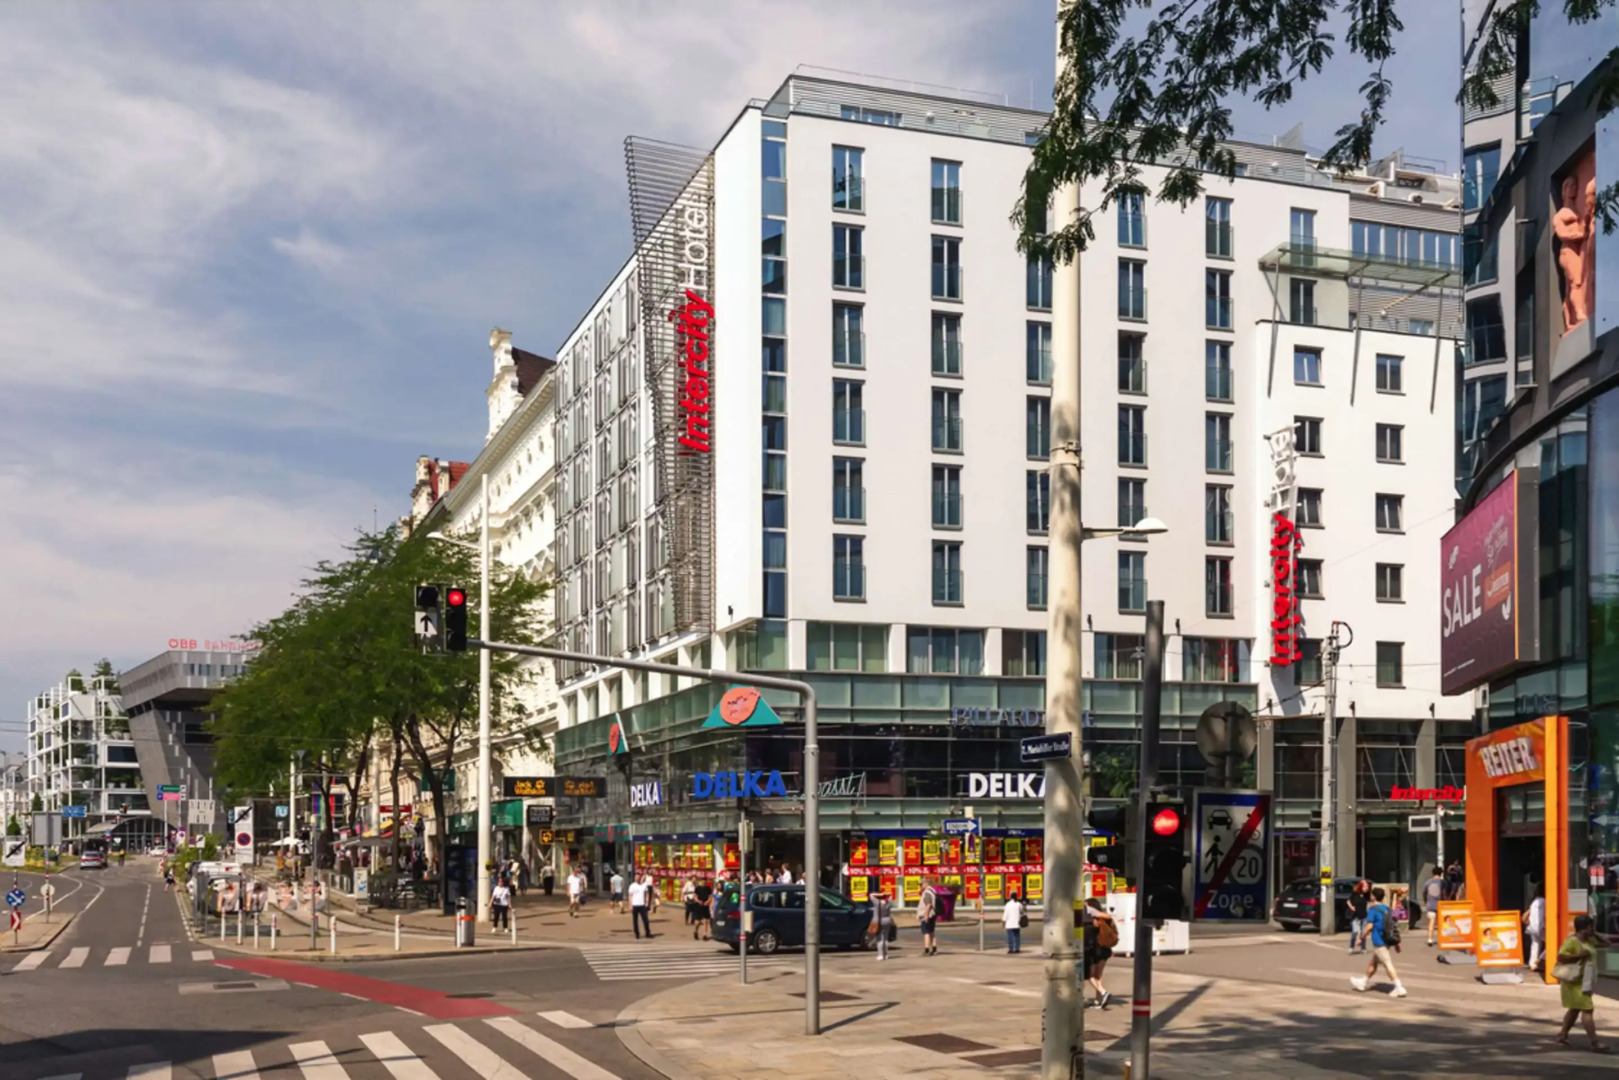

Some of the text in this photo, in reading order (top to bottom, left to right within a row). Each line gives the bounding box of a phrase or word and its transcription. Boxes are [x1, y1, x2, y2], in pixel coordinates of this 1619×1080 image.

[1443, 563, 1482, 638] SALE
[1480, 737, 1538, 777] REITER
[631, 782, 660, 807] DELKA
[694, 770, 787, 799] DELKA
[1390, 784, 1464, 804] Intercity
[1238, 857, 1259, 878] 20
[1207, 890, 1253, 909] Zone
